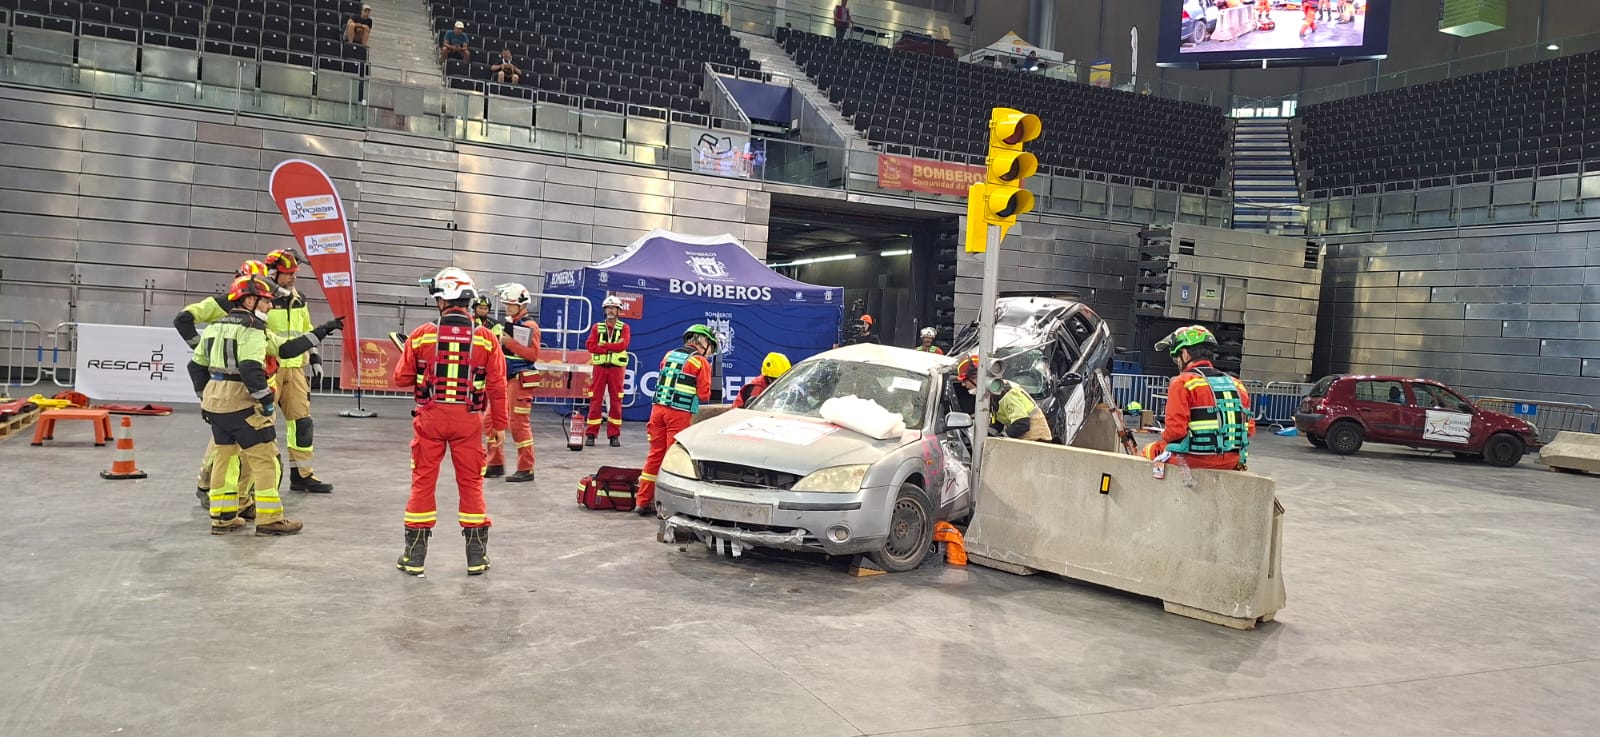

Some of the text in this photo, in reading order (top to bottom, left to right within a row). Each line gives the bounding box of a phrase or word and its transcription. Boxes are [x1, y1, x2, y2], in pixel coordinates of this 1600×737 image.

[912, 177, 954, 190] Comunidad
[669, 278, 773, 302] BOMBEROS
[87, 359, 175, 373] RESCATE
